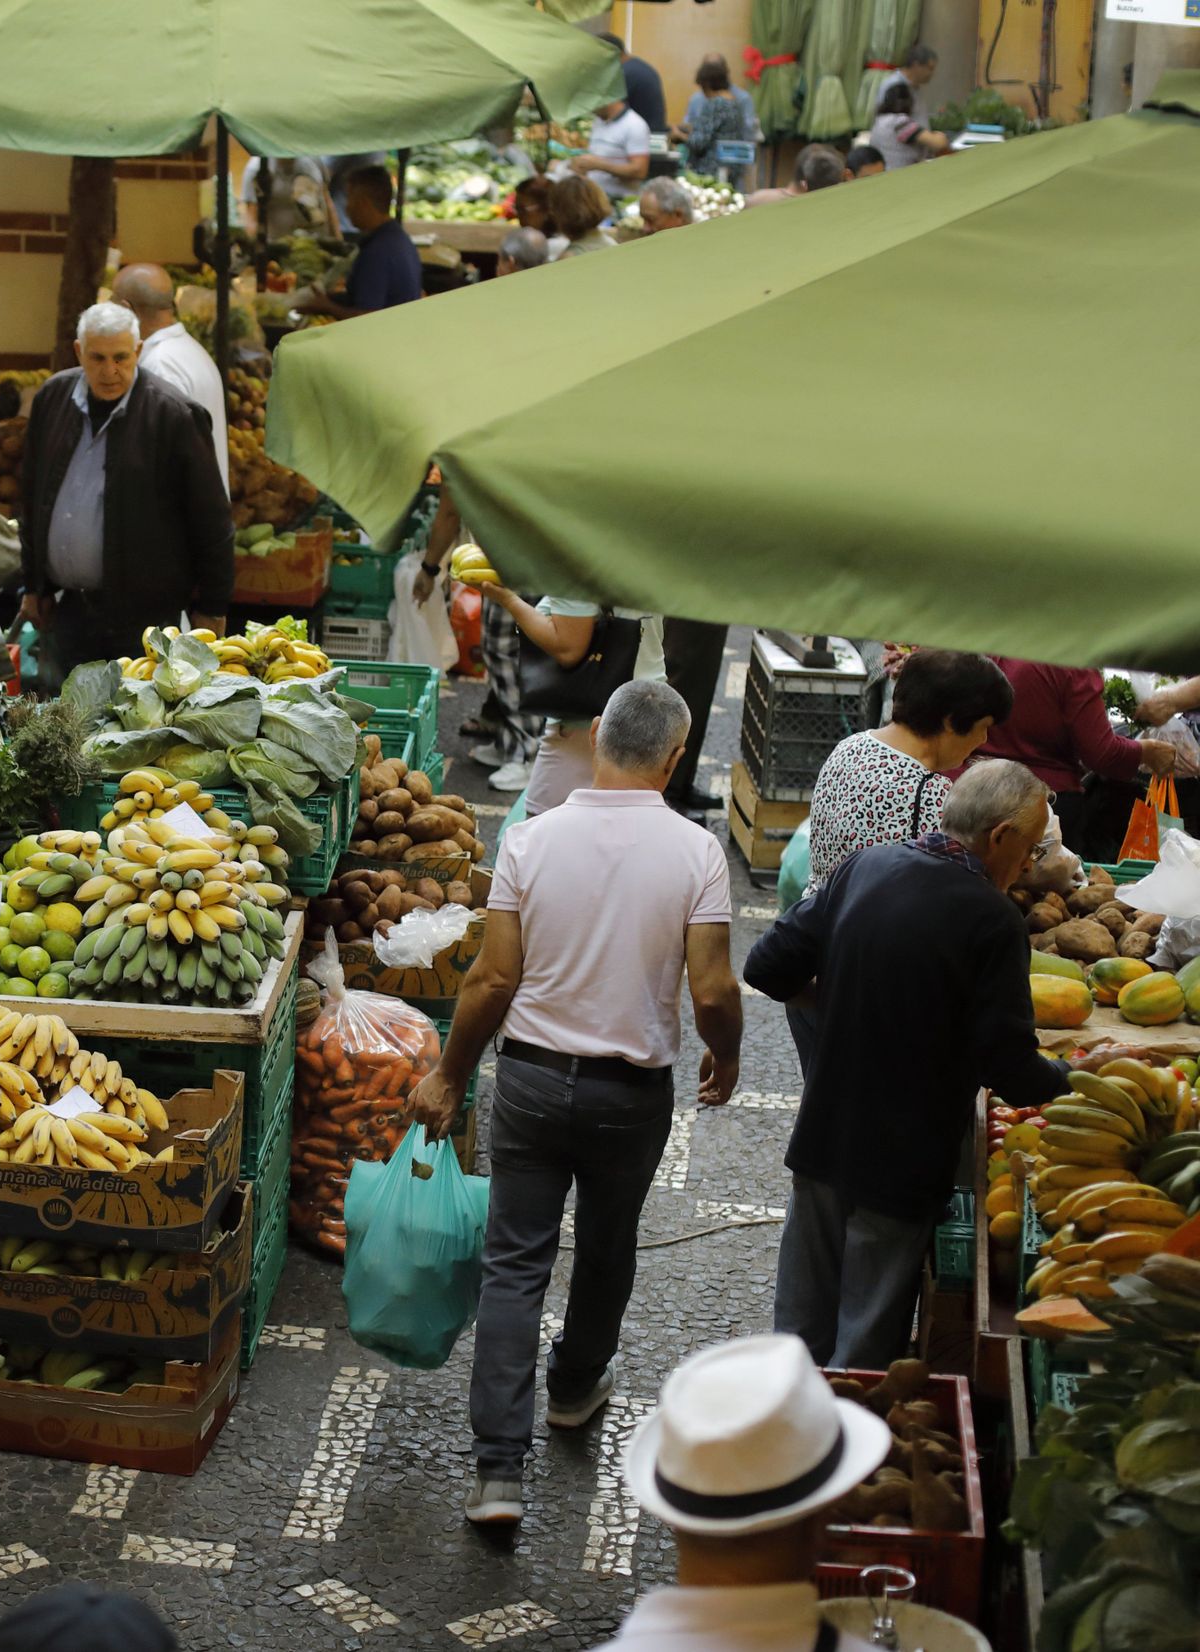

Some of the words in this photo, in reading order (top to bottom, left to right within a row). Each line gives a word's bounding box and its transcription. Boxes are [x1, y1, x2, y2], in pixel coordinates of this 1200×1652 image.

[399, 866, 449, 879] Madeira
[64, 1172, 140, 1194] Madeira
[74, 1282, 146, 1302] Madeira
